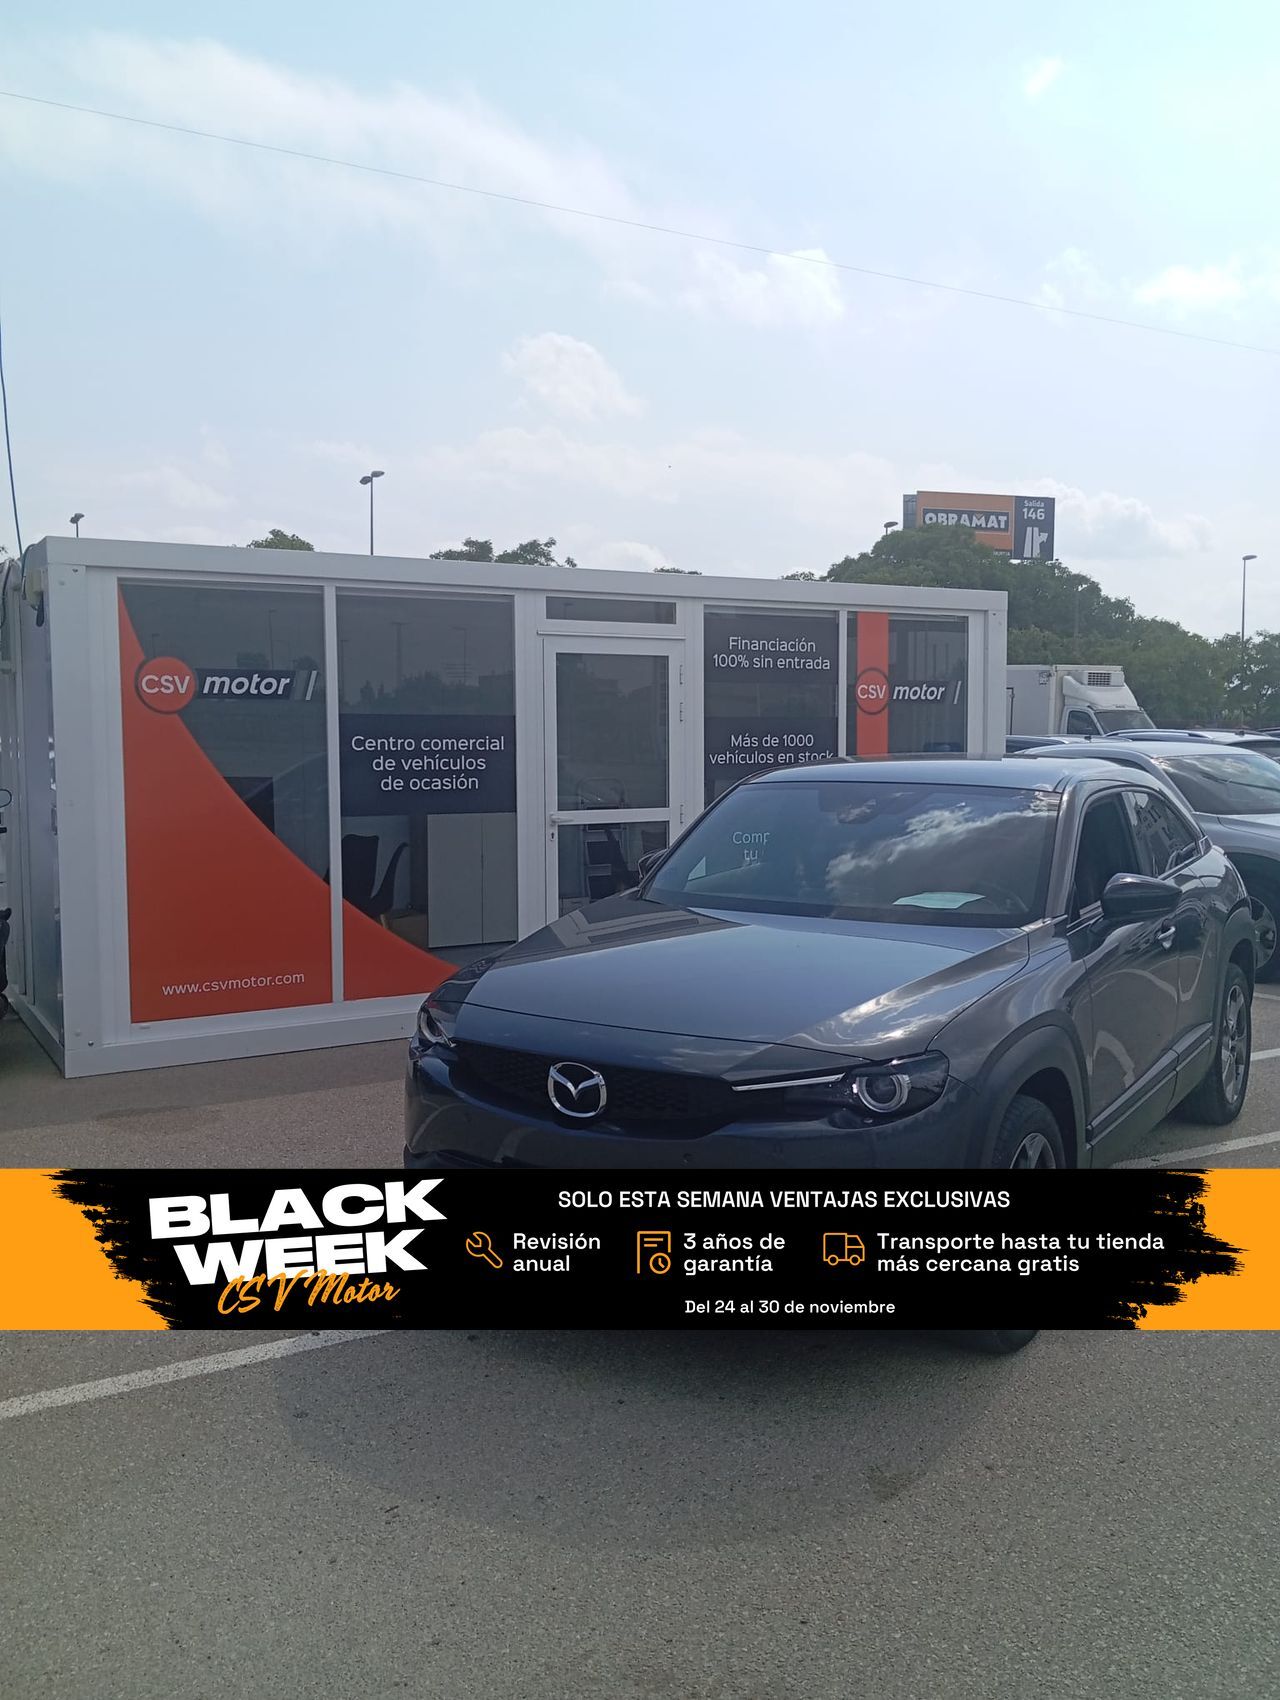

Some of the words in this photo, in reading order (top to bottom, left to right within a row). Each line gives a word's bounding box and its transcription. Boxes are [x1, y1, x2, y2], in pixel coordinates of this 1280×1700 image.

[1023, 500, 1045, 508] Salida
[924, 512, 1008, 529] OBRAMAT
[1022, 508, 1045, 520] 146
[729, 636, 816, 652] Financiación
[713, 654, 749, 668] 100%
[753, 655, 773, 668] sin
[777, 657, 831, 670] entrada
[140, 675, 190, 694] CSV
[203, 673, 290, 695] motor
[857, 684, 886, 699] CSV
[893, 683, 946, 700] motor
[351, 736, 415, 751] Centro
[420, 736, 505, 751] comercial
[730, 733, 759, 747] Más
[762, 734, 779, 747] de
[783, 734, 814, 747] 1000
[372, 756, 396, 771] de
[401, 754, 487, 770] vehículos
[709, 750, 774, 764] vehículos
[777, 752, 795, 763] en
[380, 776, 404, 791] de
[409, 773, 479, 791] ocasión
[162, 972, 305, 996] www.csvmotor.com
